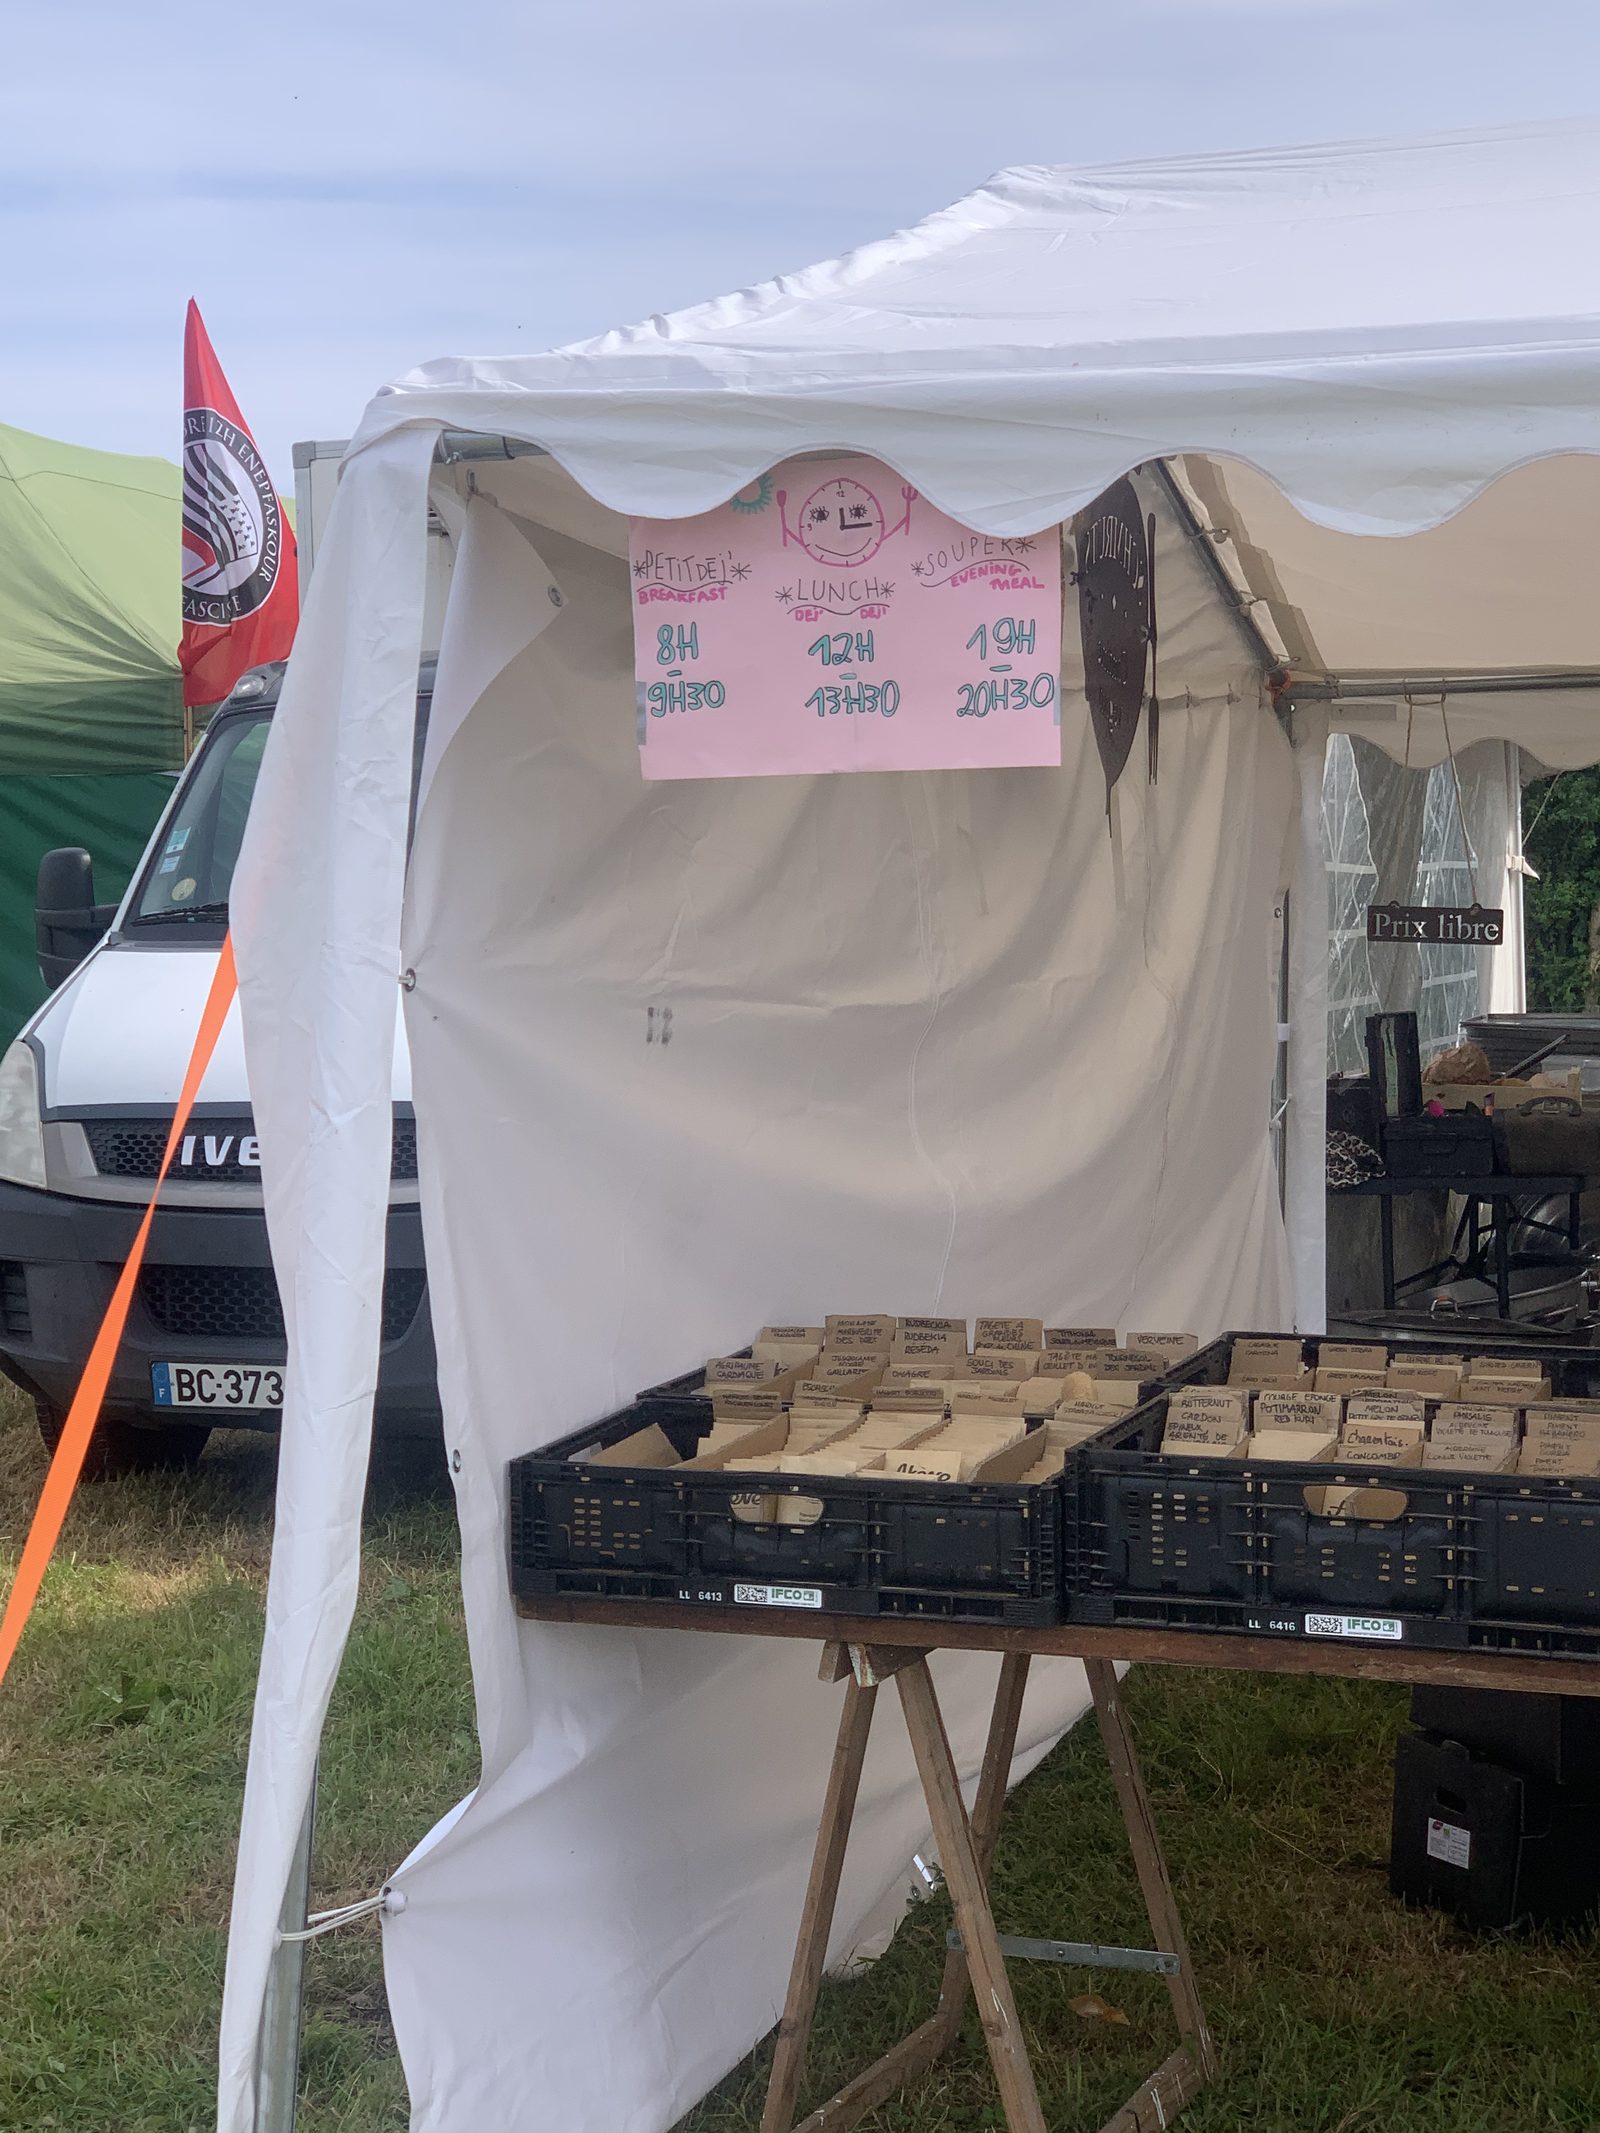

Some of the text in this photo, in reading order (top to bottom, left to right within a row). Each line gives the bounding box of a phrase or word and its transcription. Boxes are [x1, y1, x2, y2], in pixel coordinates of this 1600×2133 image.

[238, 443, 277, 582] ENEPFASKOUR
[797, 577, 879, 602] LUNCH
[989, 576, 1045, 590] MEAL
[639, 587, 728, 605] BREAKFAST
[657, 621, 699, 666] 8H
[966, 617, 1036, 660] 19H
[808, 630, 875, 666] 12H
[648, 680, 726, 718] 9H30
[805, 680, 900, 717] 13H30
[956, 673, 1055, 718] 20H30
[1374, 912, 1499, 941] Prix libre
[1137, 1335, 1184, 1346] VERVEINE
[1181, 1411, 1222, 1424] CARDON
[1260, 1402, 1321, 1415] POTIMARRON
[1364, 1405, 1399, 1414] MELON
[679, 1590, 722, 1601] LL 6413
[771, 1587, 802, 1600] IFCO
[1248, 1619, 1296, 1631] LL 6416
[1347, 1618, 1381, 1631] IFCO
